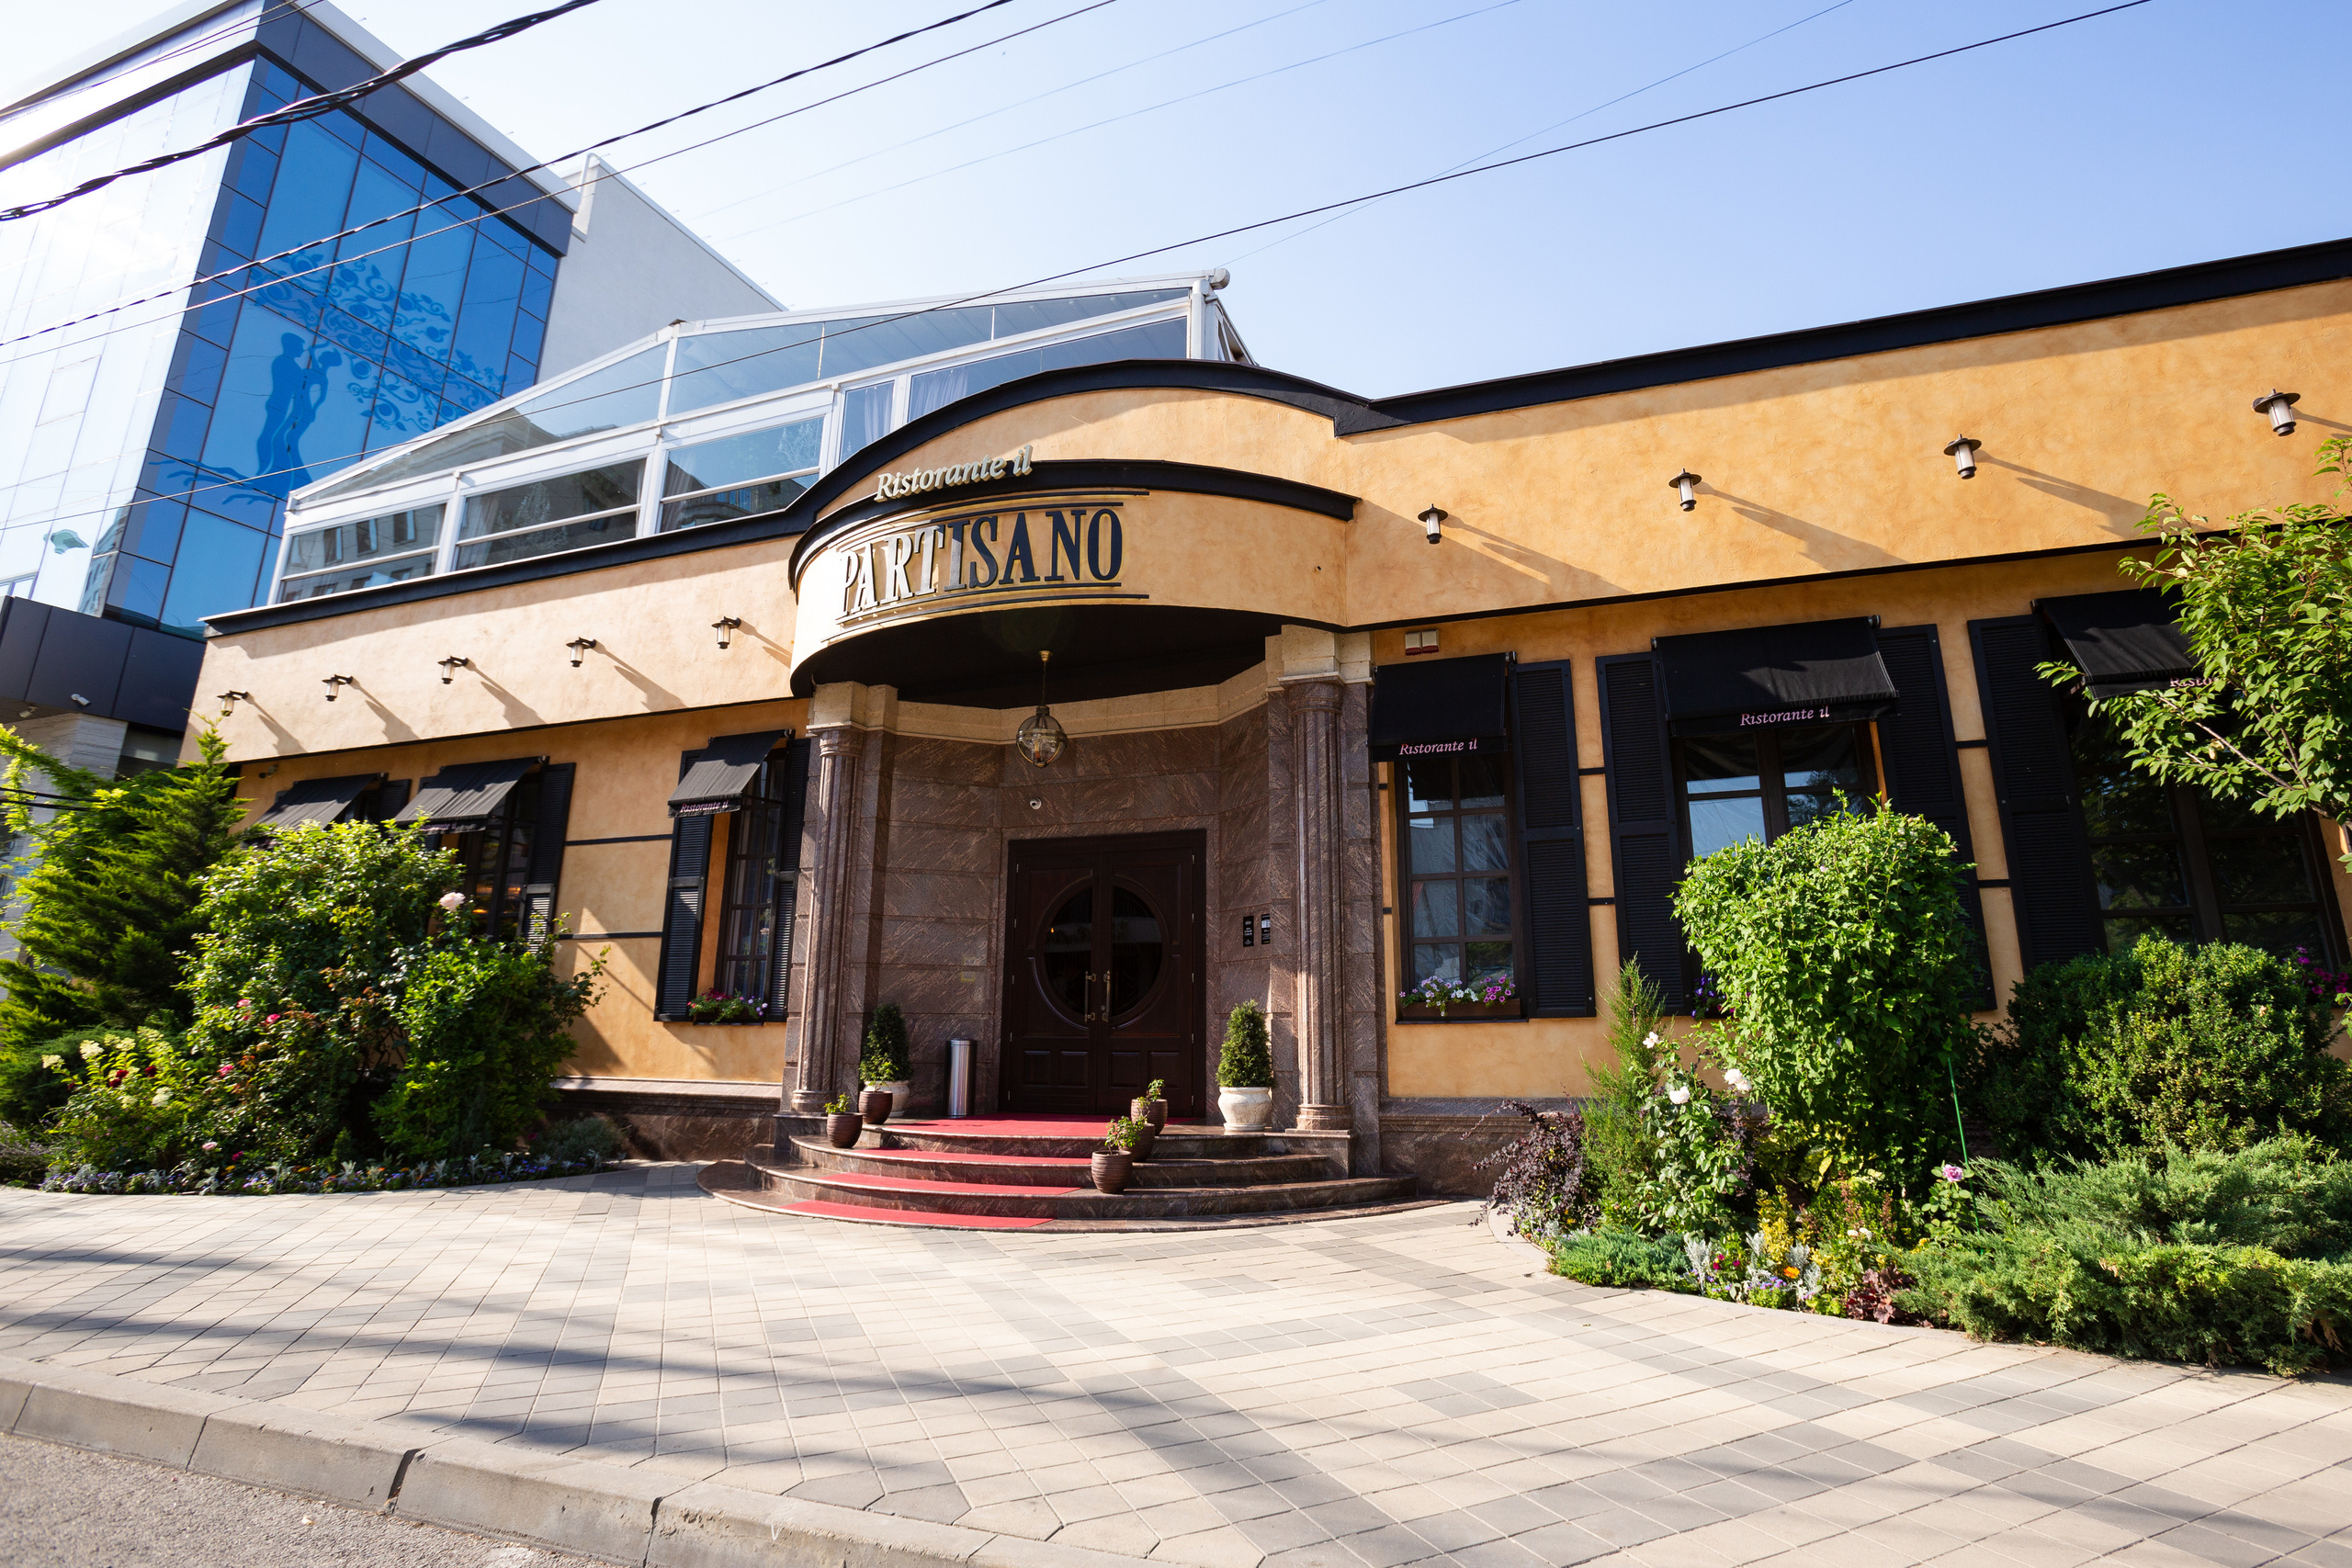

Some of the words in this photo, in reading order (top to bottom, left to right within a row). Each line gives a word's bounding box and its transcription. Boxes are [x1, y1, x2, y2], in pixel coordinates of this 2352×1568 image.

[874, 454, 1007, 502] Ristorante
[1012, 445, 1035, 475] il
[835, 508, 1123, 618] PARTISANO
[1740, 707, 1814, 727] Ristorante
[1819, 705, 1830, 718] il
[1399, 740, 1464, 755] Ristorante
[1468, 738, 1477, 750] il
[680, 802, 720, 812] Ristorante
